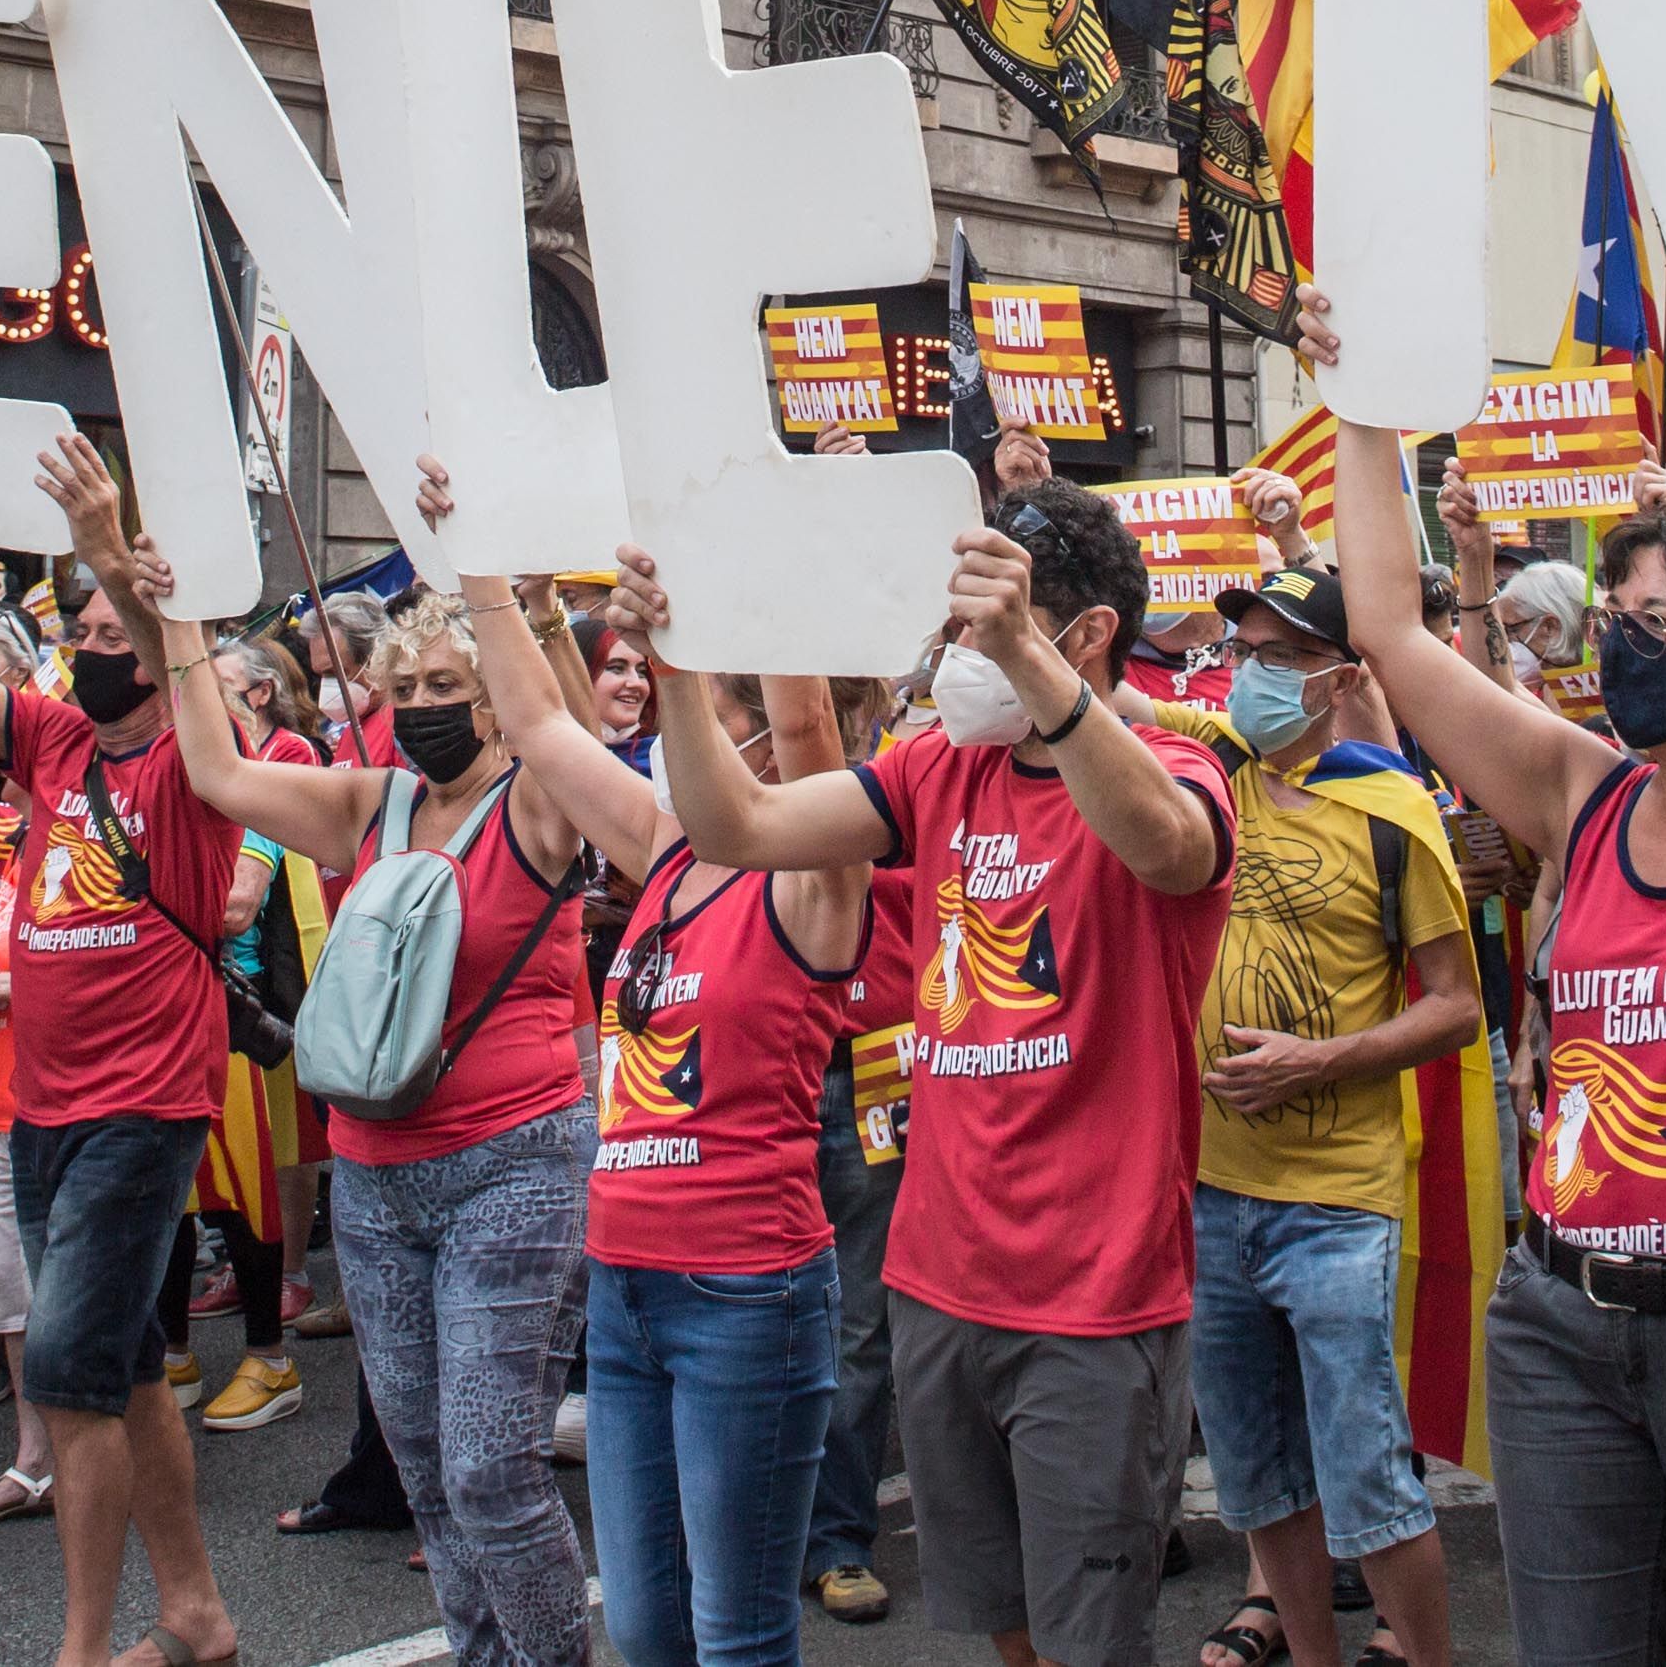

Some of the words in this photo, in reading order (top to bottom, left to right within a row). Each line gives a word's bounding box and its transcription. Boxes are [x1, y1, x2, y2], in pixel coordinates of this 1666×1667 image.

[965, 24, 1017, 76] OCTUBRE
[1015, 71, 1048, 100] 2017
[793, 315, 847, 358] HEM
[990, 296, 1045, 348] HEM
[783, 378, 883, 422] GUANYAT
[987, 371, 1090, 427] GUANYAT
[1476, 378, 1612, 425] EXIGIM
[1530, 430, 1561, 463] LA
[1109, 485, 1233, 524] XIGIM
[1468, 468, 1636, 512] NDEPENDÈNCIA
[1151, 529, 1182, 559] LA
[1148, 567, 1256, 604] ENDÈNCIA
[102, 816, 130, 857] Nikon
[28, 922, 138, 953] INDEPENDÈNCIA
[1553, 965, 1660, 1013] LLUITEM
[930, 1033, 1070, 1077] INDEPNDÈNCIA
